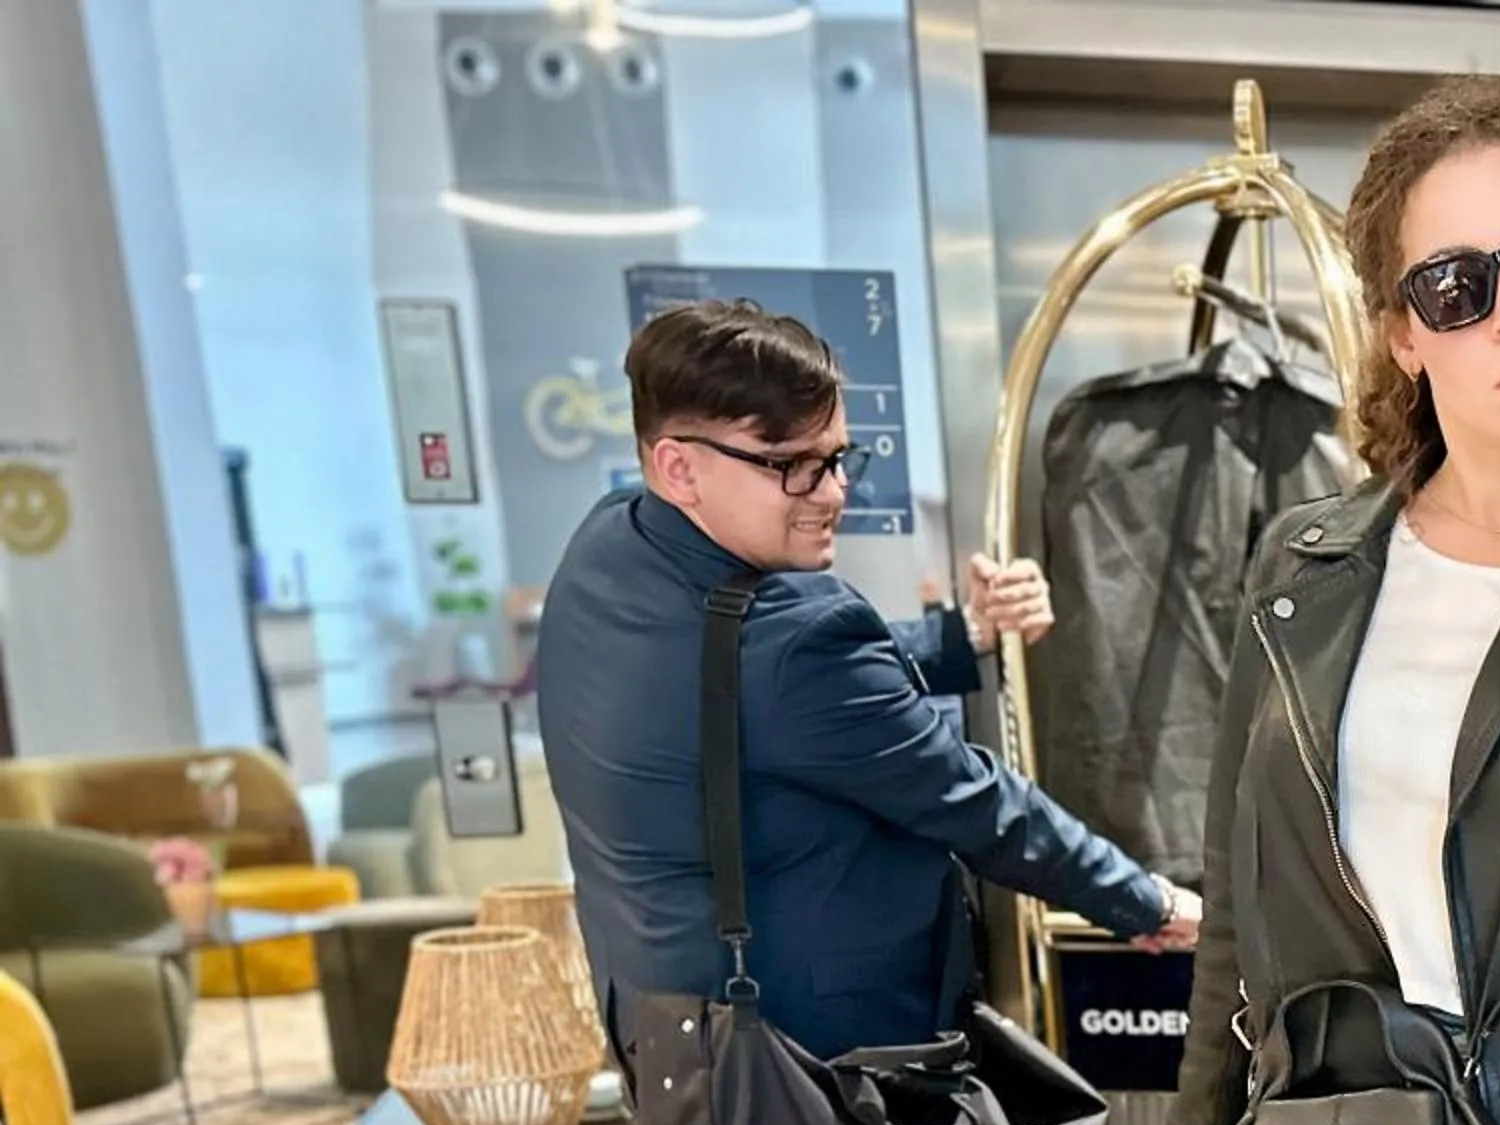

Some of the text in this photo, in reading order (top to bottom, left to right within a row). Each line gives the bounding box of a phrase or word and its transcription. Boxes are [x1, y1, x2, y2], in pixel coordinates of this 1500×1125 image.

[865, 278, 880, 299] 2
[867, 314, 881, 336] 7
[876, 393, 886, 413] 1
